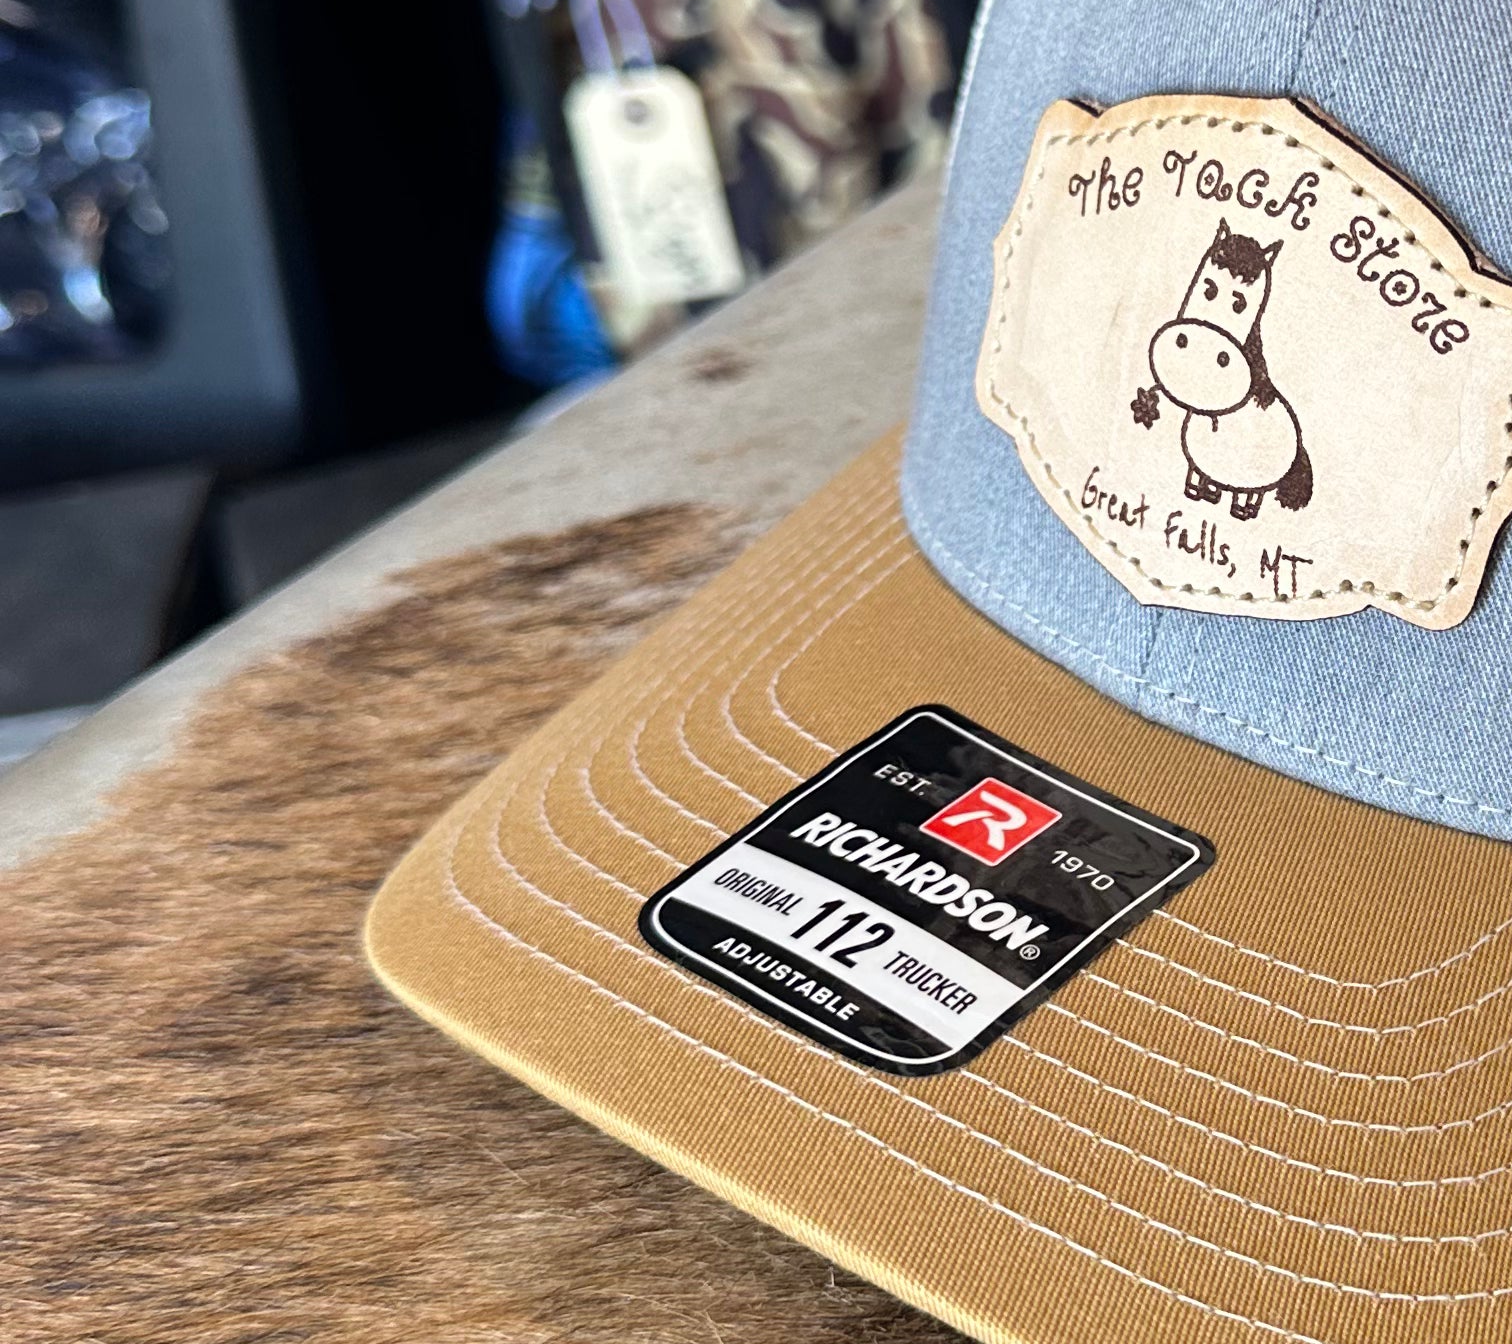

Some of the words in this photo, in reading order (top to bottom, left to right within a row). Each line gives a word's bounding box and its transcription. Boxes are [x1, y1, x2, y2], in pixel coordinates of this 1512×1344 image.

[1068, 156, 1144, 217] The
[1163, 150, 1320, 231] Tack
[1330, 215, 1471, 355] Store
[1081, 465, 1150, 529] Great
[1164, 510, 1237, 578] Falls,
[1260, 545, 1314, 599] MT
[872, 763, 929, 797] EST.
[1050, 849, 1116, 892] 1970
[712, 937, 860, 1021] ADJUSTABLE
[713, 867, 805, 917] ORIGINAL
[789, 899, 896, 970] 112
[883, 951, 978, 1016] TRUCKER
